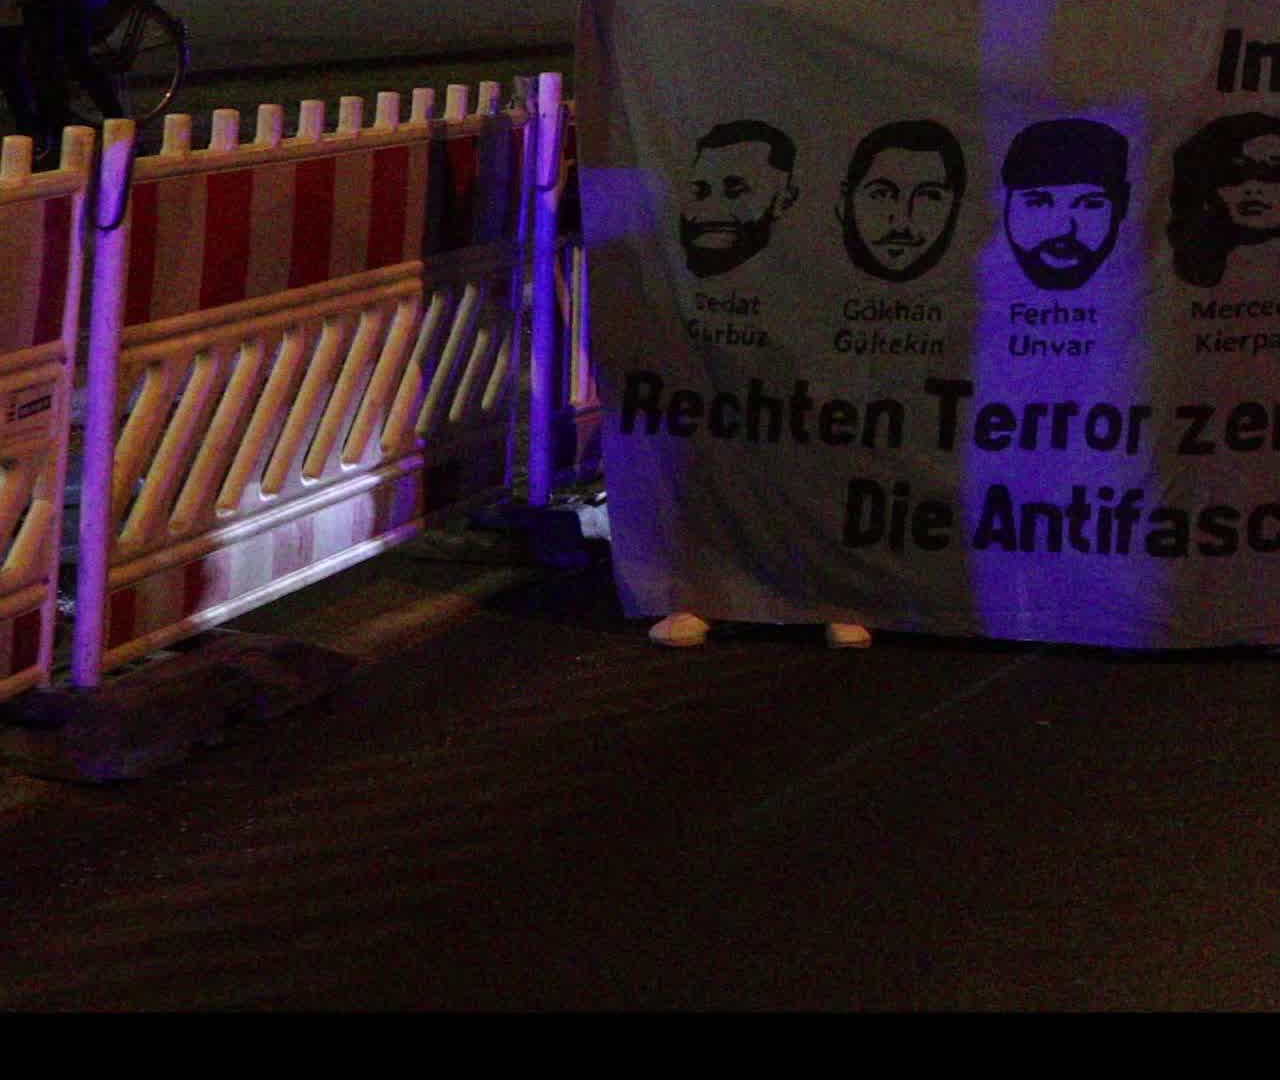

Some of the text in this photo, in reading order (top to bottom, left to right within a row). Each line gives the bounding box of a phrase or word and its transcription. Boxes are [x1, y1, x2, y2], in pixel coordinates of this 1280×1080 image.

[1009, 300, 1098, 324] Ferhat
[1008, 334, 1096, 358] Unvar
[619, 368, 904, 449] Rechten
[925, 377, 1152, 454] Terror
[841, 477, 954, 552] Die
